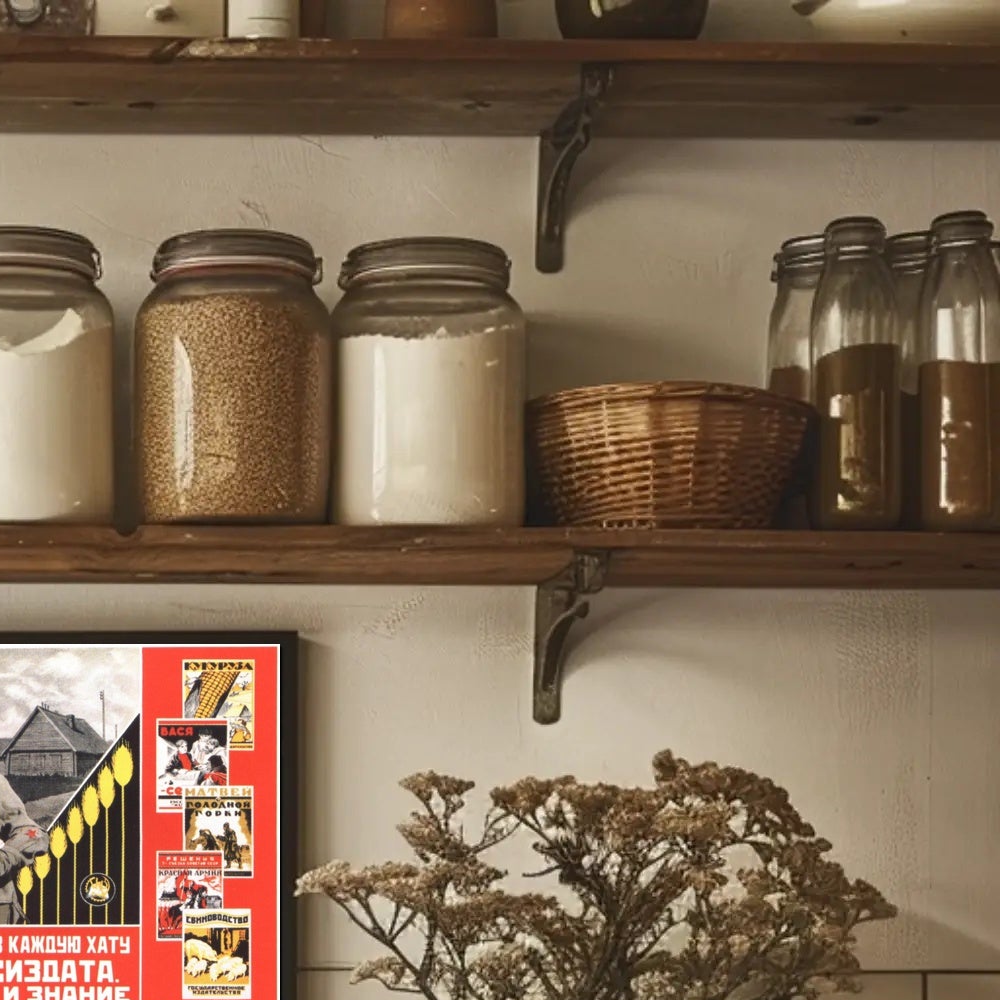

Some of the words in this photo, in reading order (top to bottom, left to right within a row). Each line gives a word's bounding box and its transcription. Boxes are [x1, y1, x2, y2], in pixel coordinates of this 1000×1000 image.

[160, 727, 194, 736] ВАСЯ
[186, 913, 248, 924] СВИНОВОДСТВО
[8, 936, 81, 954] КАЖДУЮ
[86, 936, 130, 954] ХАТУ
